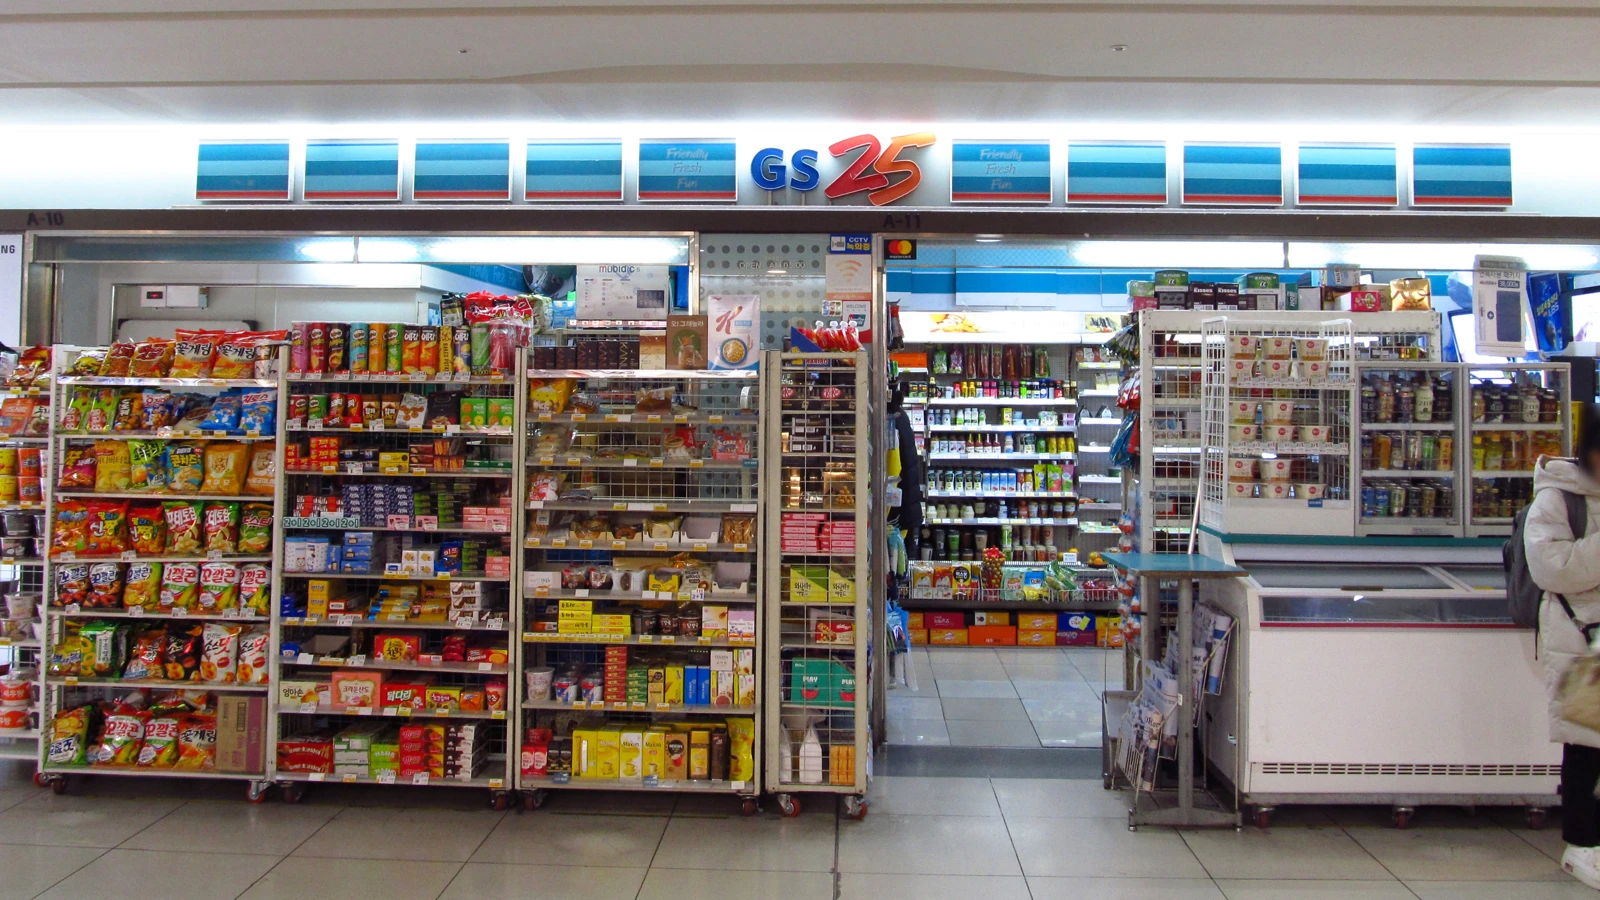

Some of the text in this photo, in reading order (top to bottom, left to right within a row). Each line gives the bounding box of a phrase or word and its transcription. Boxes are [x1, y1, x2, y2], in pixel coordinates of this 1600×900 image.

[666, 148, 708, 161] Friendly
[980, 148, 1023, 162] Friendly
[673, 162, 702, 174] Fresh
[750, 131, 936, 206] GS 25
[986, 163, 1016, 175] Fresh
[677, 178, 697, 189] Fun
[991, 178, 1012, 190] Fun
[27, 212, 64, 226] A-10
[884, 213, 921, 229] A-11
[176, 342, 212, 356] 꽃게랑
[220, 344, 256, 359] 꽃게랑
[242, 393, 269, 404] 치토스
[283, 518, 301, 527] 2+1
[303, 518, 320, 527] 2+1
[321, 518, 339, 528] 2+1
[341, 518, 359, 528] 2+1
[59, 566, 88, 582] 꼬깔콘
[91, 569, 116, 584] 꼬깔콘
[202, 568, 236, 583] 꼬깔콘
[283, 688, 304, 698] 엄마손
[343, 686, 370, 694] 크라운산도
[106, 721, 139, 738] 꼬깔콘
[181, 729, 216, 743] 꽃게랑
